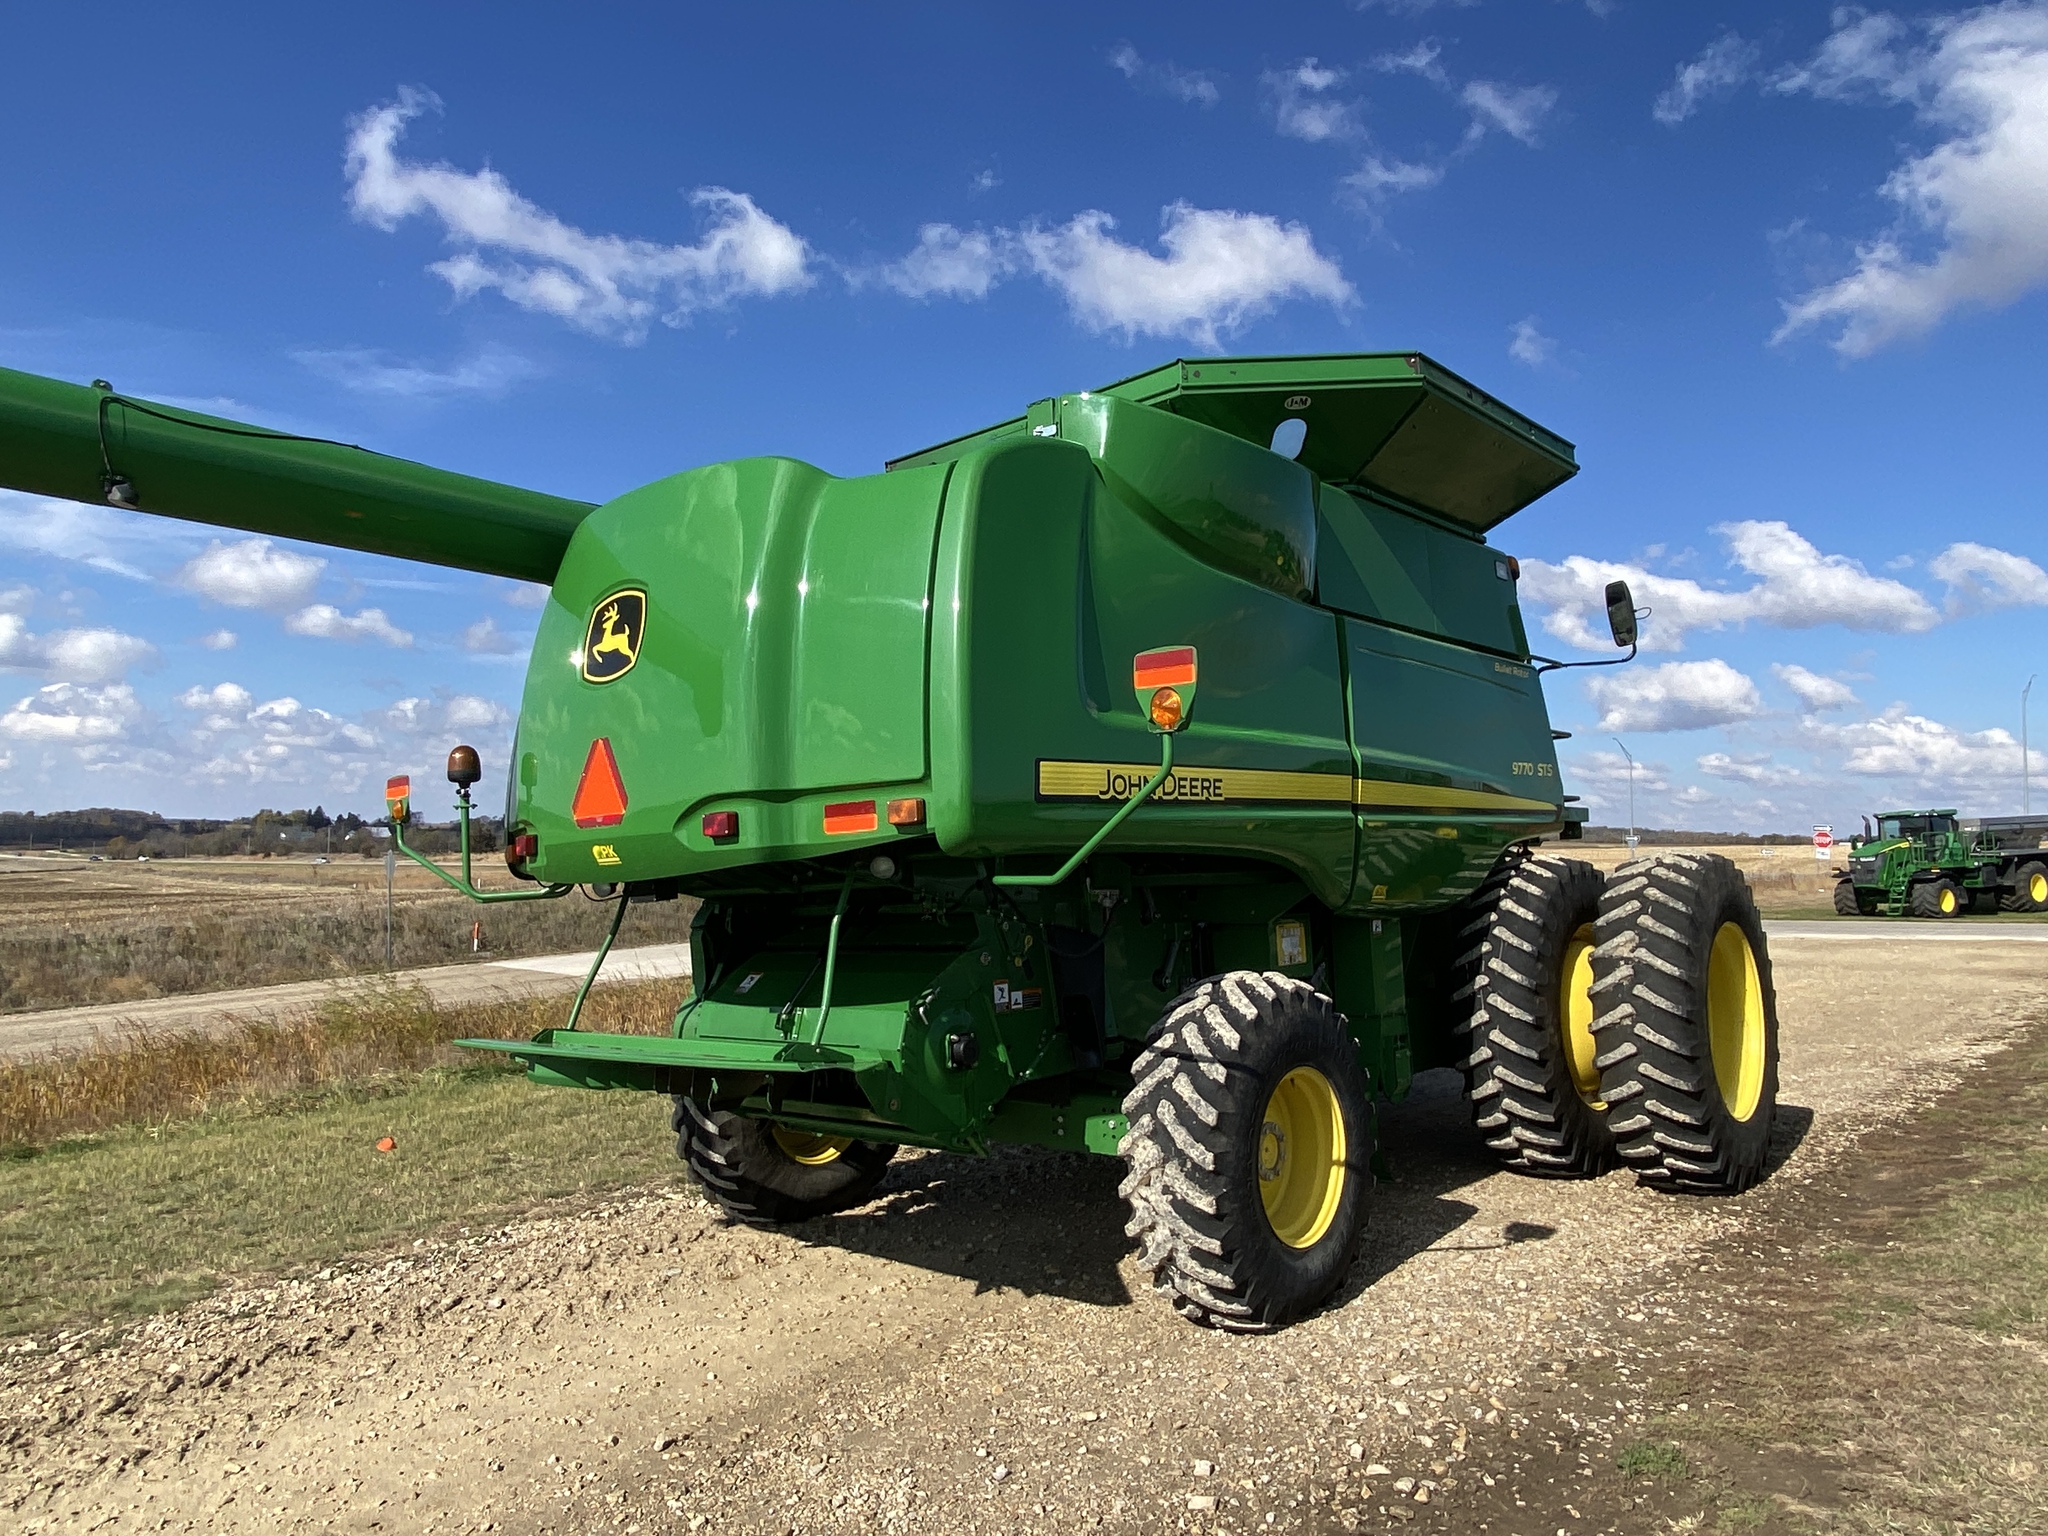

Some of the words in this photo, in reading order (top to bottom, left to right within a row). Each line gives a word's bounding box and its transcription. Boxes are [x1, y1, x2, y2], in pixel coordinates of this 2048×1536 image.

[1512, 761, 1534, 776] 9770
[1537, 763, 1553, 777] STS
[1162, 772, 1224, 798] DEERE
[1814, 836, 1832, 844] STOP
